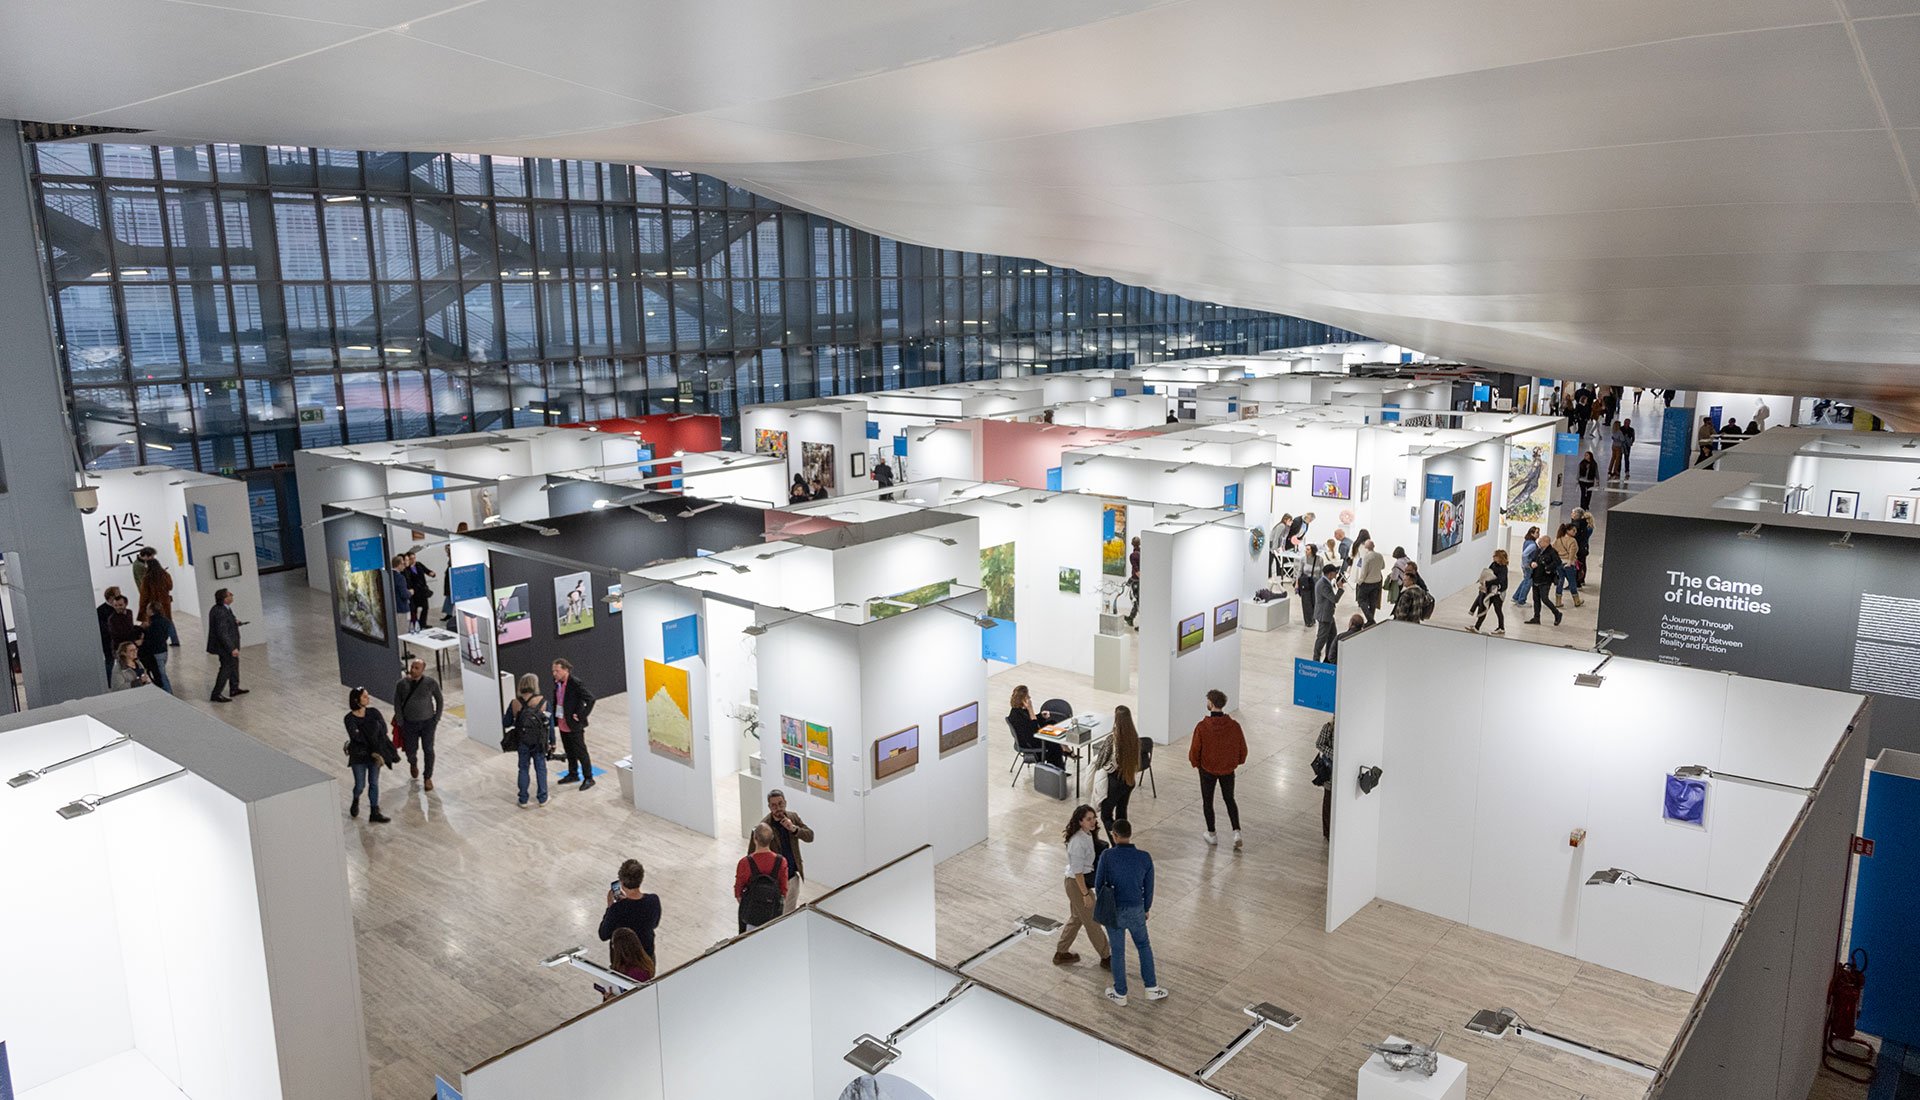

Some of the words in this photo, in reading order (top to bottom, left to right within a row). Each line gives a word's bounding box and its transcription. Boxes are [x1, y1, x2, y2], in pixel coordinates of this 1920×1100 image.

[1666, 570, 1702, 588] The
[1706, 575, 1763, 596] Game
[1664, 589, 1683, 603] of
[1686, 590, 1772, 614] Identities
[1661, 622, 1715, 637] Contemporary
[1669, 615, 1700, 626] Journey
[1700, 618, 1734, 631] Through
[1660, 630, 1708, 644] Photography
[1709, 636, 1743, 648] Between
[1660, 637, 1685, 649] Reality
[1685, 641, 1700, 650] and
[1701, 644, 1727, 654] Fiction
[1298, 662, 1335, 676] Contemporary
[1298, 669, 1318, 678] Cluster
